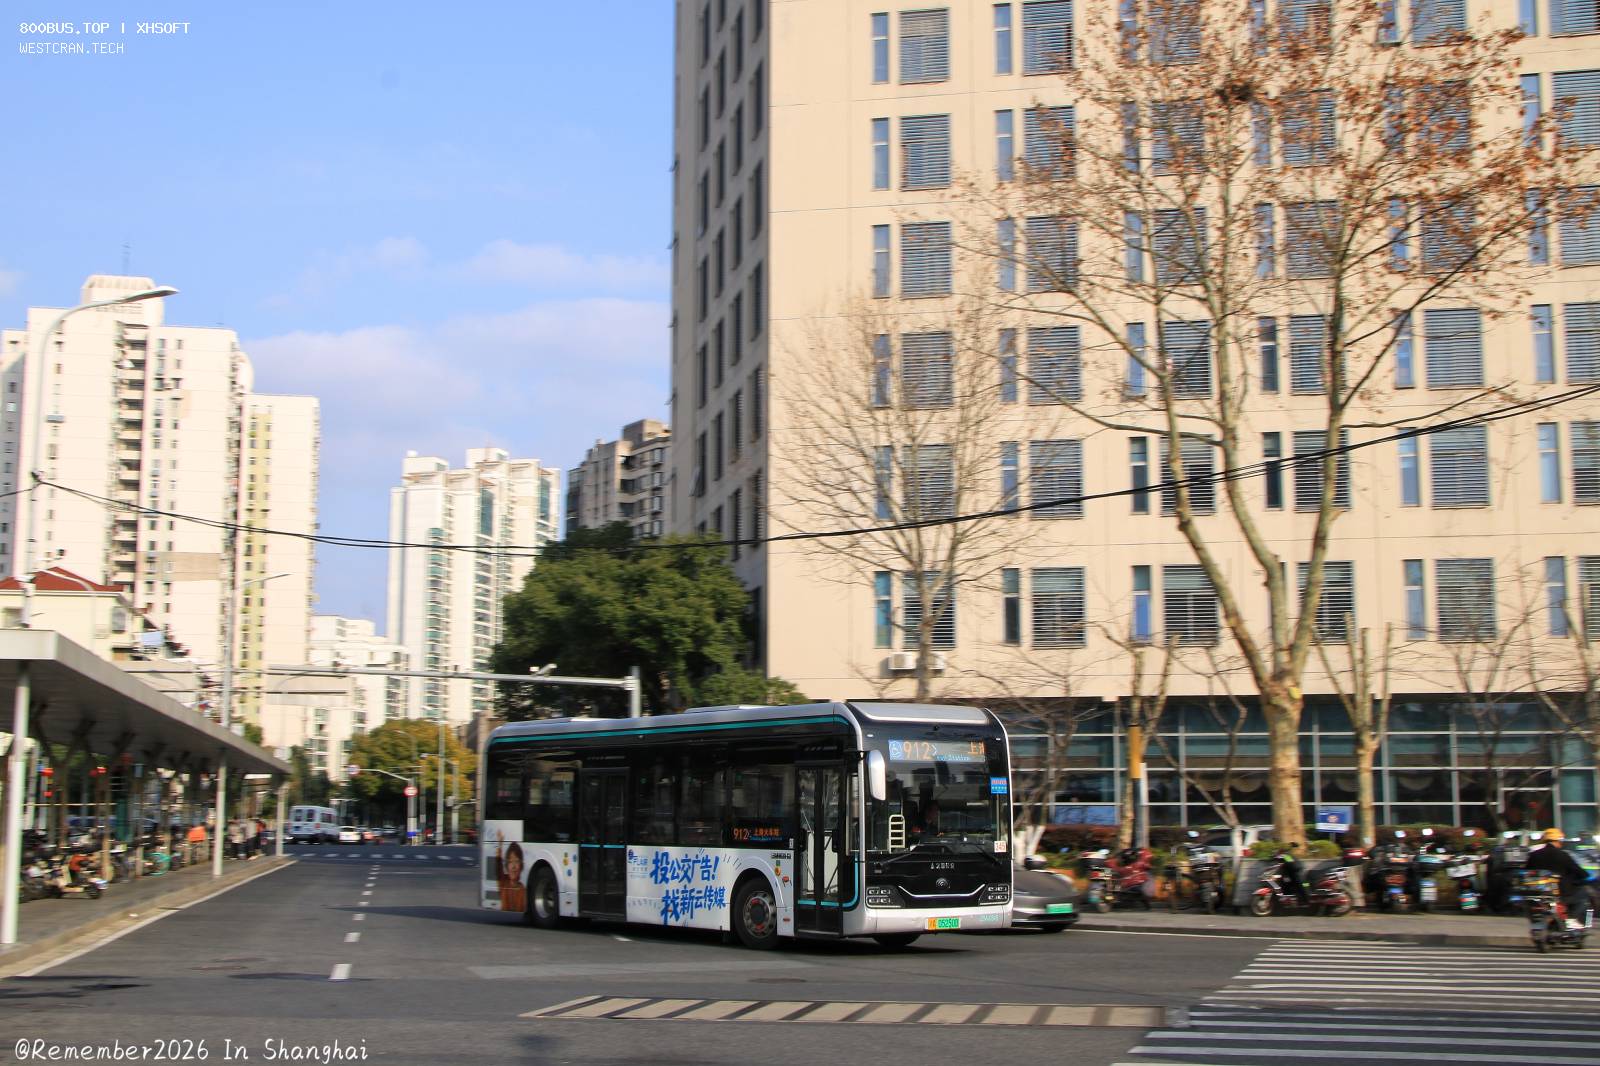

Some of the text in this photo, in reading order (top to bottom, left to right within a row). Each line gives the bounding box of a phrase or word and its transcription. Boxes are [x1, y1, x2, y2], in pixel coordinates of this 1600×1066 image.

[903, 741, 932, 760] 912
[733, 827, 750, 840] 912
[650, 850, 720, 885] 投公交广告!
[660, 884, 727, 926] 找新云传媒
